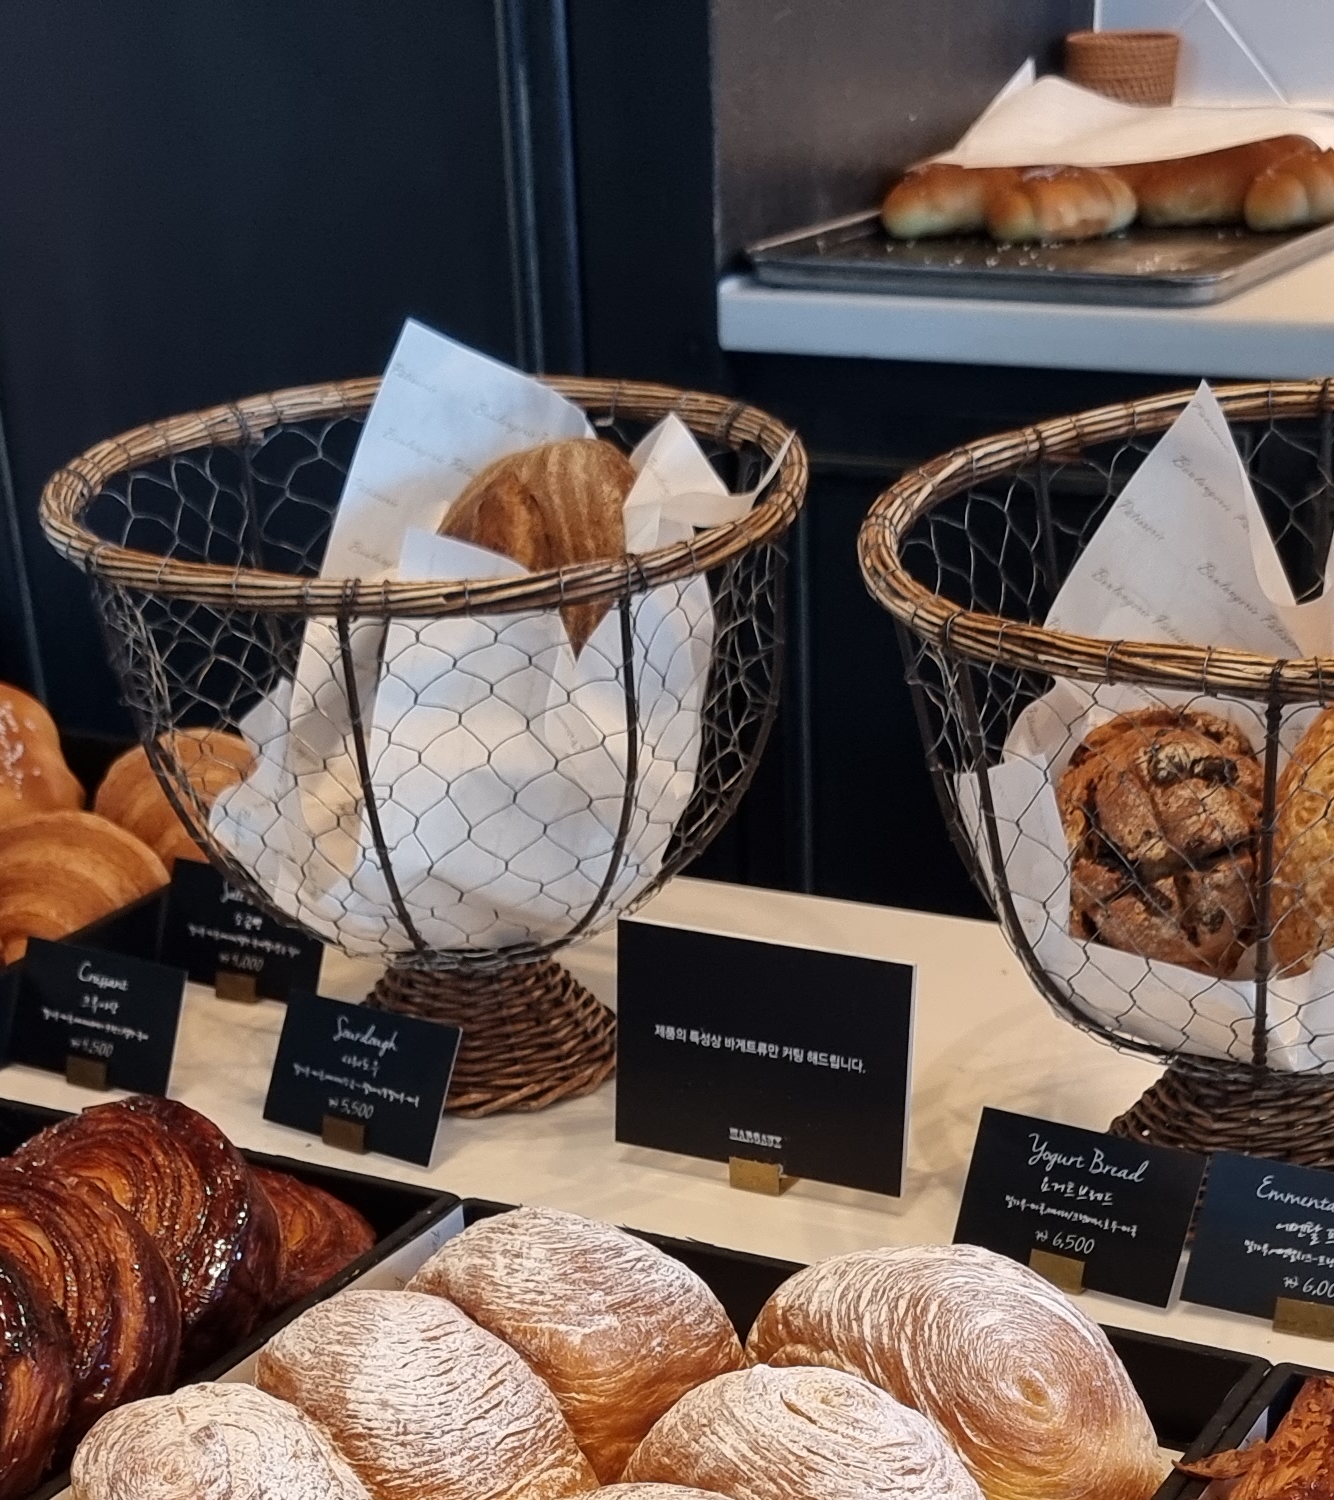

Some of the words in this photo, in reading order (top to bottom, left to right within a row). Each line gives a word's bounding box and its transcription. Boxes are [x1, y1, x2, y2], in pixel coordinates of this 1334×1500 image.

[654, 1023, 687, 1043] 제품의
[1028, 1132, 1085, 1171] Yogurt
[1088, 1148, 1150, 1183] Bread
